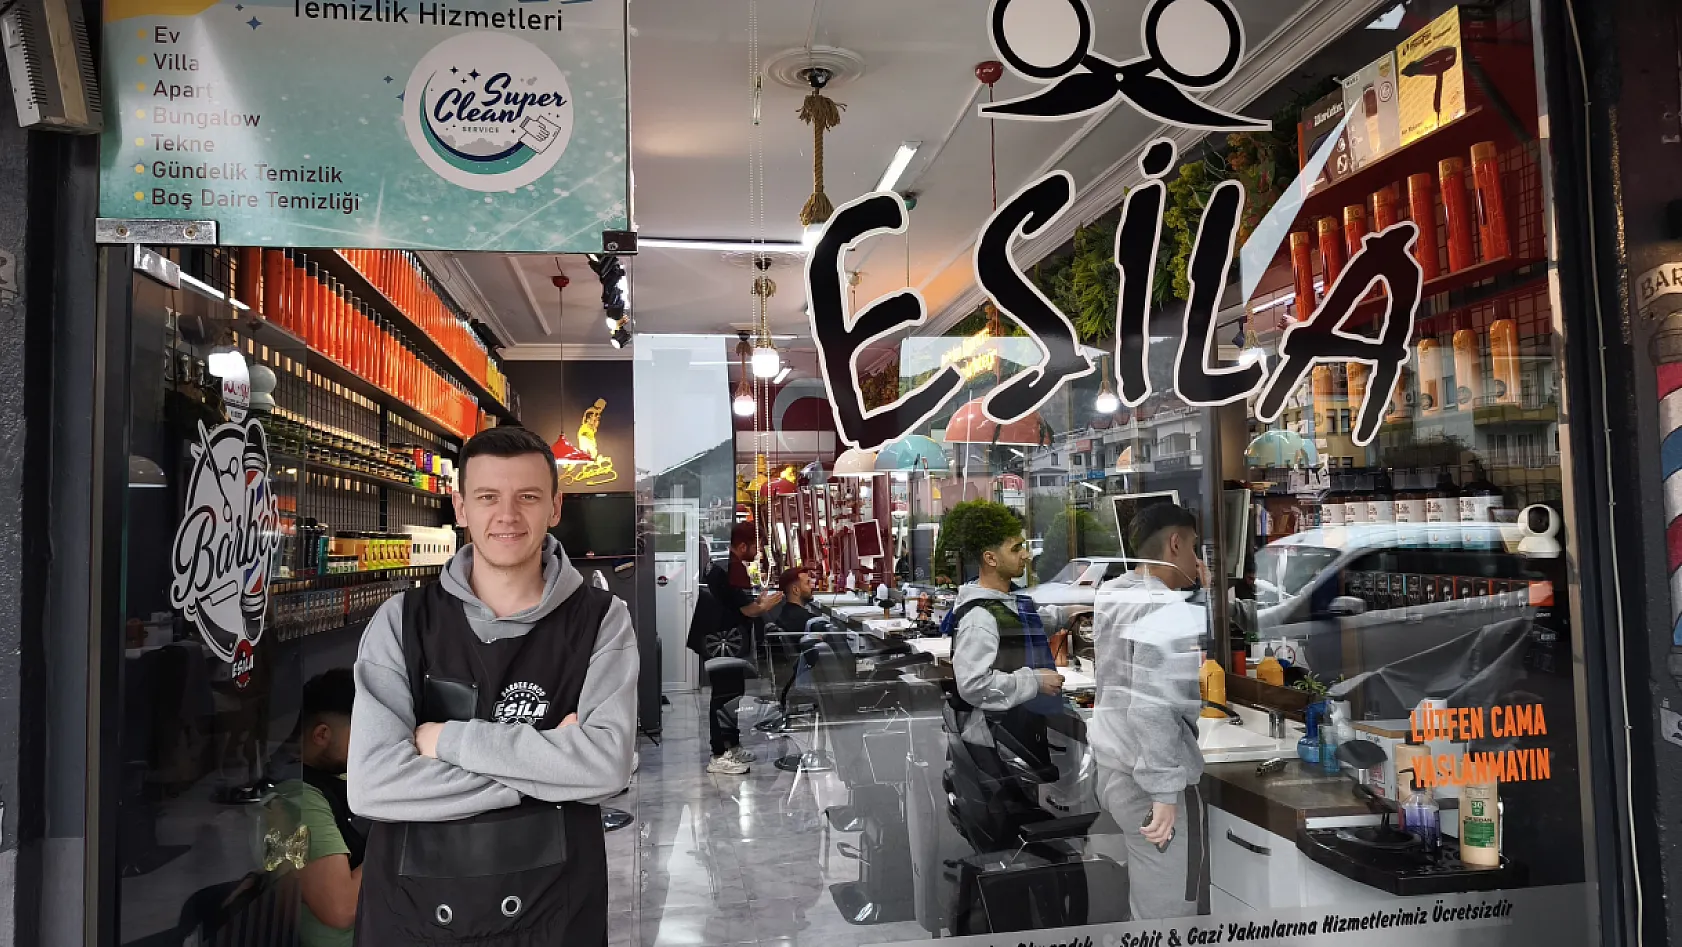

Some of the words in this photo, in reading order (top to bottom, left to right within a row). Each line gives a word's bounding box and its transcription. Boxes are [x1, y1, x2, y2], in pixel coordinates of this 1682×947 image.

[419, 2, 563, 31] Hizmetleri
[154, 26, 181, 44] Ev
[153, 52, 200, 71] Villa
[153, 79, 212, 101] Apart
[482, 72, 567, 118] Super
[153, 106, 261, 129] Bungalow
[434, 88, 516, 123] Clean
[151, 133, 215, 152] Tekne
[461, 126, 500, 134] SERVICE
[152, 160, 247, 180] Gündelik
[255, 163, 343, 183] Temizlik
[152, 188, 193, 210] Boş
[201, 188, 258, 207] Daire
[265, 191, 360, 214] Temizliği
[804, 138, 1424, 449] ESİLA
[171, 494, 281, 603] Barber
[495, 700, 547, 717] ESİLA
[1411, 702, 1484, 742] LÜTFEN
[1491, 703, 1547, 738] CAMA
[1412, 747, 1550, 788] YASLANMAYIN
[1168, 928, 1182, 947] &
[1187, 923, 1224, 945] Gazi
[1227, 918, 1317, 942] Yakınlarına
[1322, 907, 1427, 934] Hizmetlerimiz
[1432, 899, 1513, 923] Ücretsizdir
